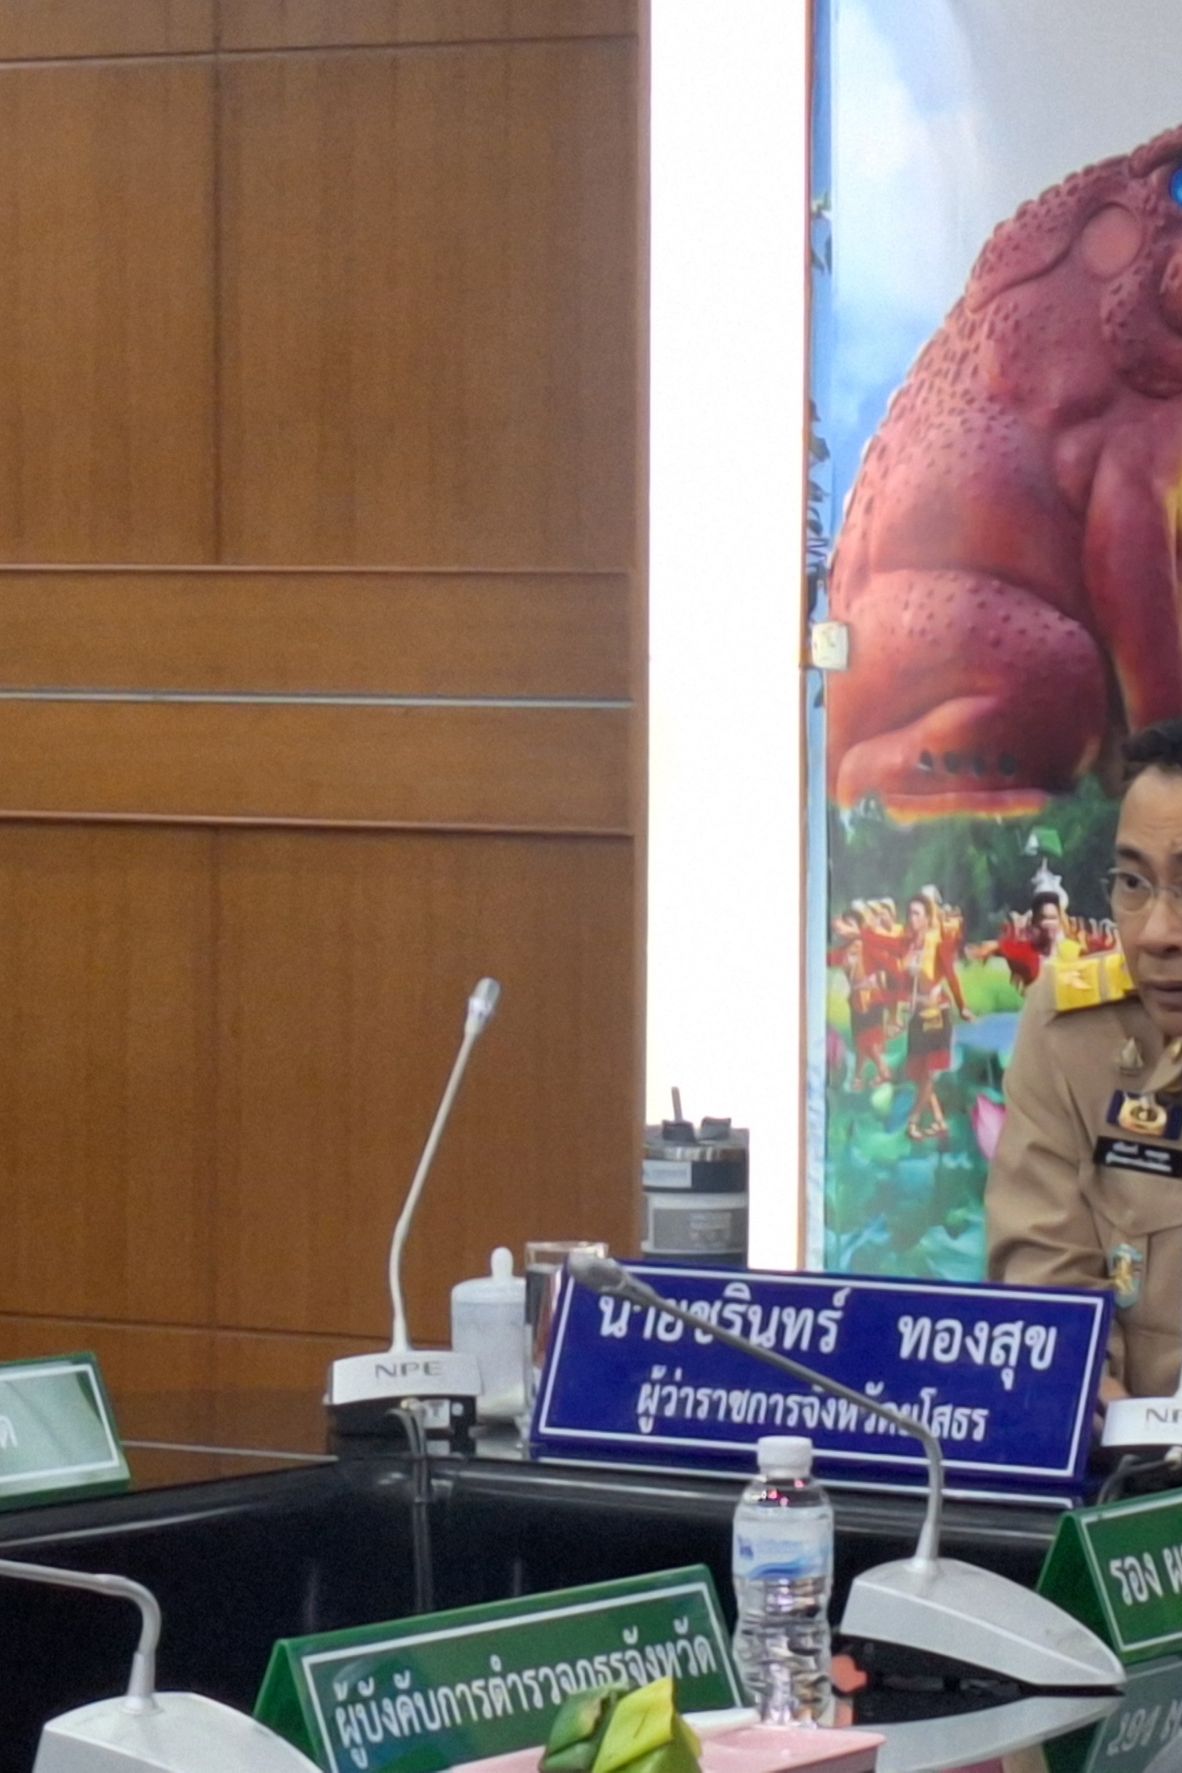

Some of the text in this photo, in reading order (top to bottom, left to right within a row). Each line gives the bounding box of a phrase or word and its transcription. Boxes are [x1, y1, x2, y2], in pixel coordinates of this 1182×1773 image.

[374, 1360, 443, 1379] NPE
[897, 1314, 1058, 1391] ทองสุข
[1109, 1551, 1164, 1607] รอง
[332, 1614, 718, 1770] ผู้บังคับการตำรวจภธรจังหวัด
